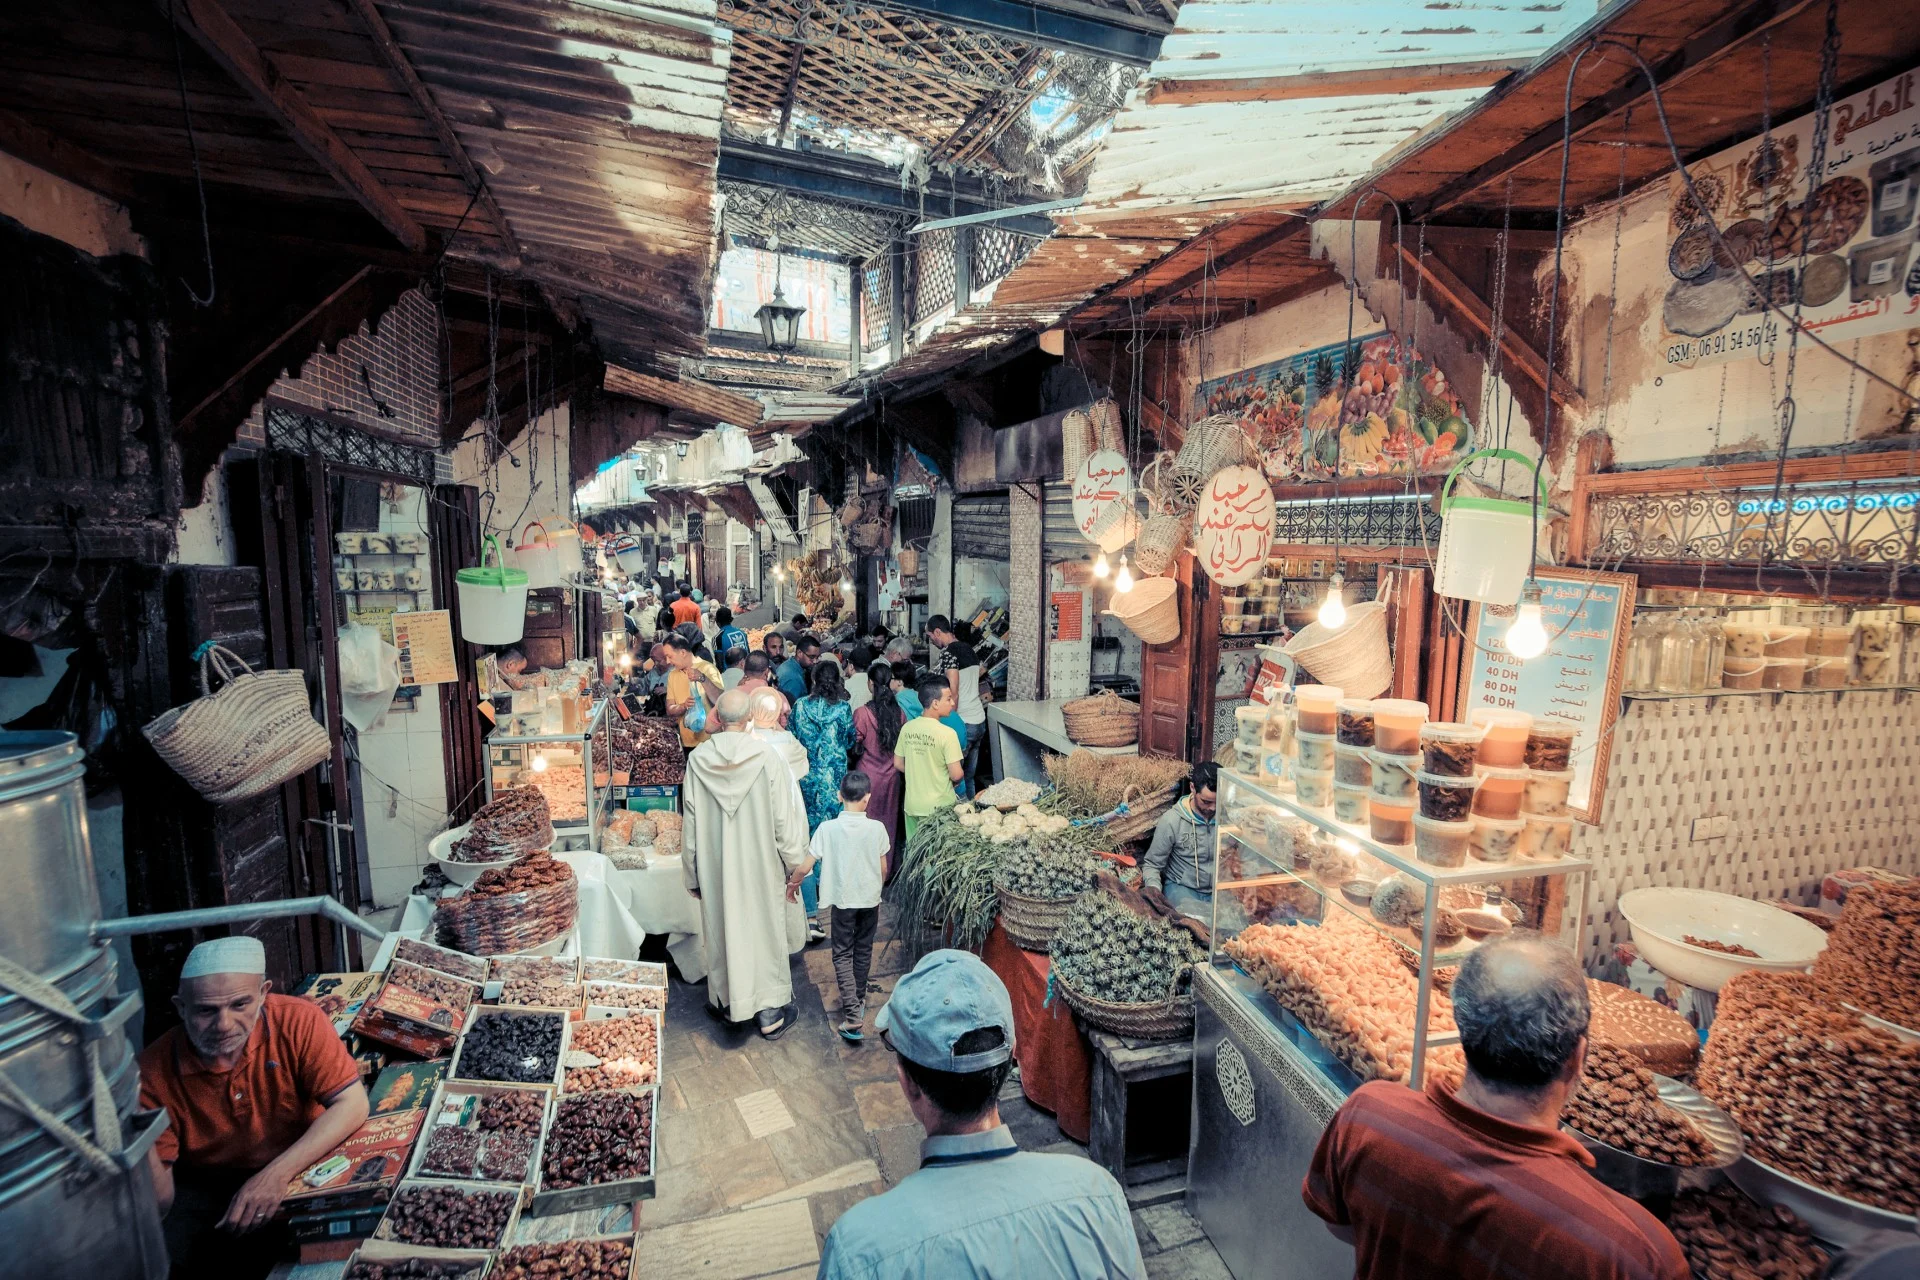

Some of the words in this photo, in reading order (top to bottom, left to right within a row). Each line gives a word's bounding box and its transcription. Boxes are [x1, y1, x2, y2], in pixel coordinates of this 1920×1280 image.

[1667, 343, 1691, 364] GSM
[1699, 338, 1712, 357] 06
[1714, 335, 1726, 353] 91
[1730, 330, 1743, 351] 54
[1746, 326, 1760, 347] 56
[1087, 459, 1126, 485] مرحبا
[1212, 477, 1267, 512] مرحبا
[1201, 507, 1238, 530] عند
[1485, 652, 1504, 663] 100
[1507, 656, 1524, 667] DH
[1486, 666, 1499, 677] 40
[1502, 669, 1519, 681] DH
[1484, 680, 1497, 691] 80
[1500, 683, 1517, 695] DH
[1482, 694, 1496, 705] 40
[1498, 697, 1515, 709] DH
[1550, 695, 1587, 708] السمن
